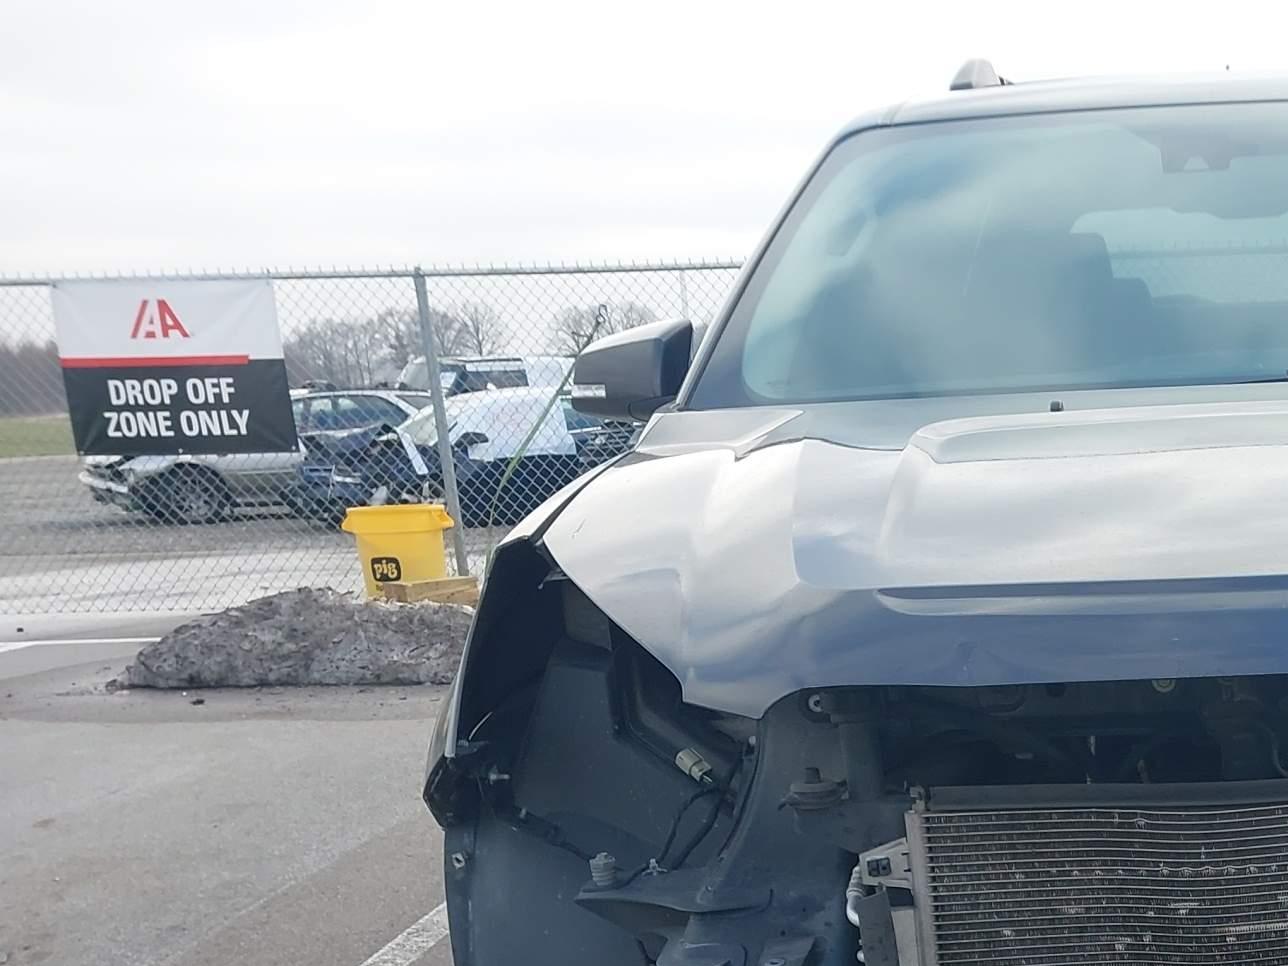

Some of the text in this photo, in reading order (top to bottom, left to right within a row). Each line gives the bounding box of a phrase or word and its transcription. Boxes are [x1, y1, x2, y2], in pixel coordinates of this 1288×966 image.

[107, 377, 235, 406] DROP OFF
[103, 409, 250, 438] ZONE ONLY
[373, 559, 398, 579] pig
